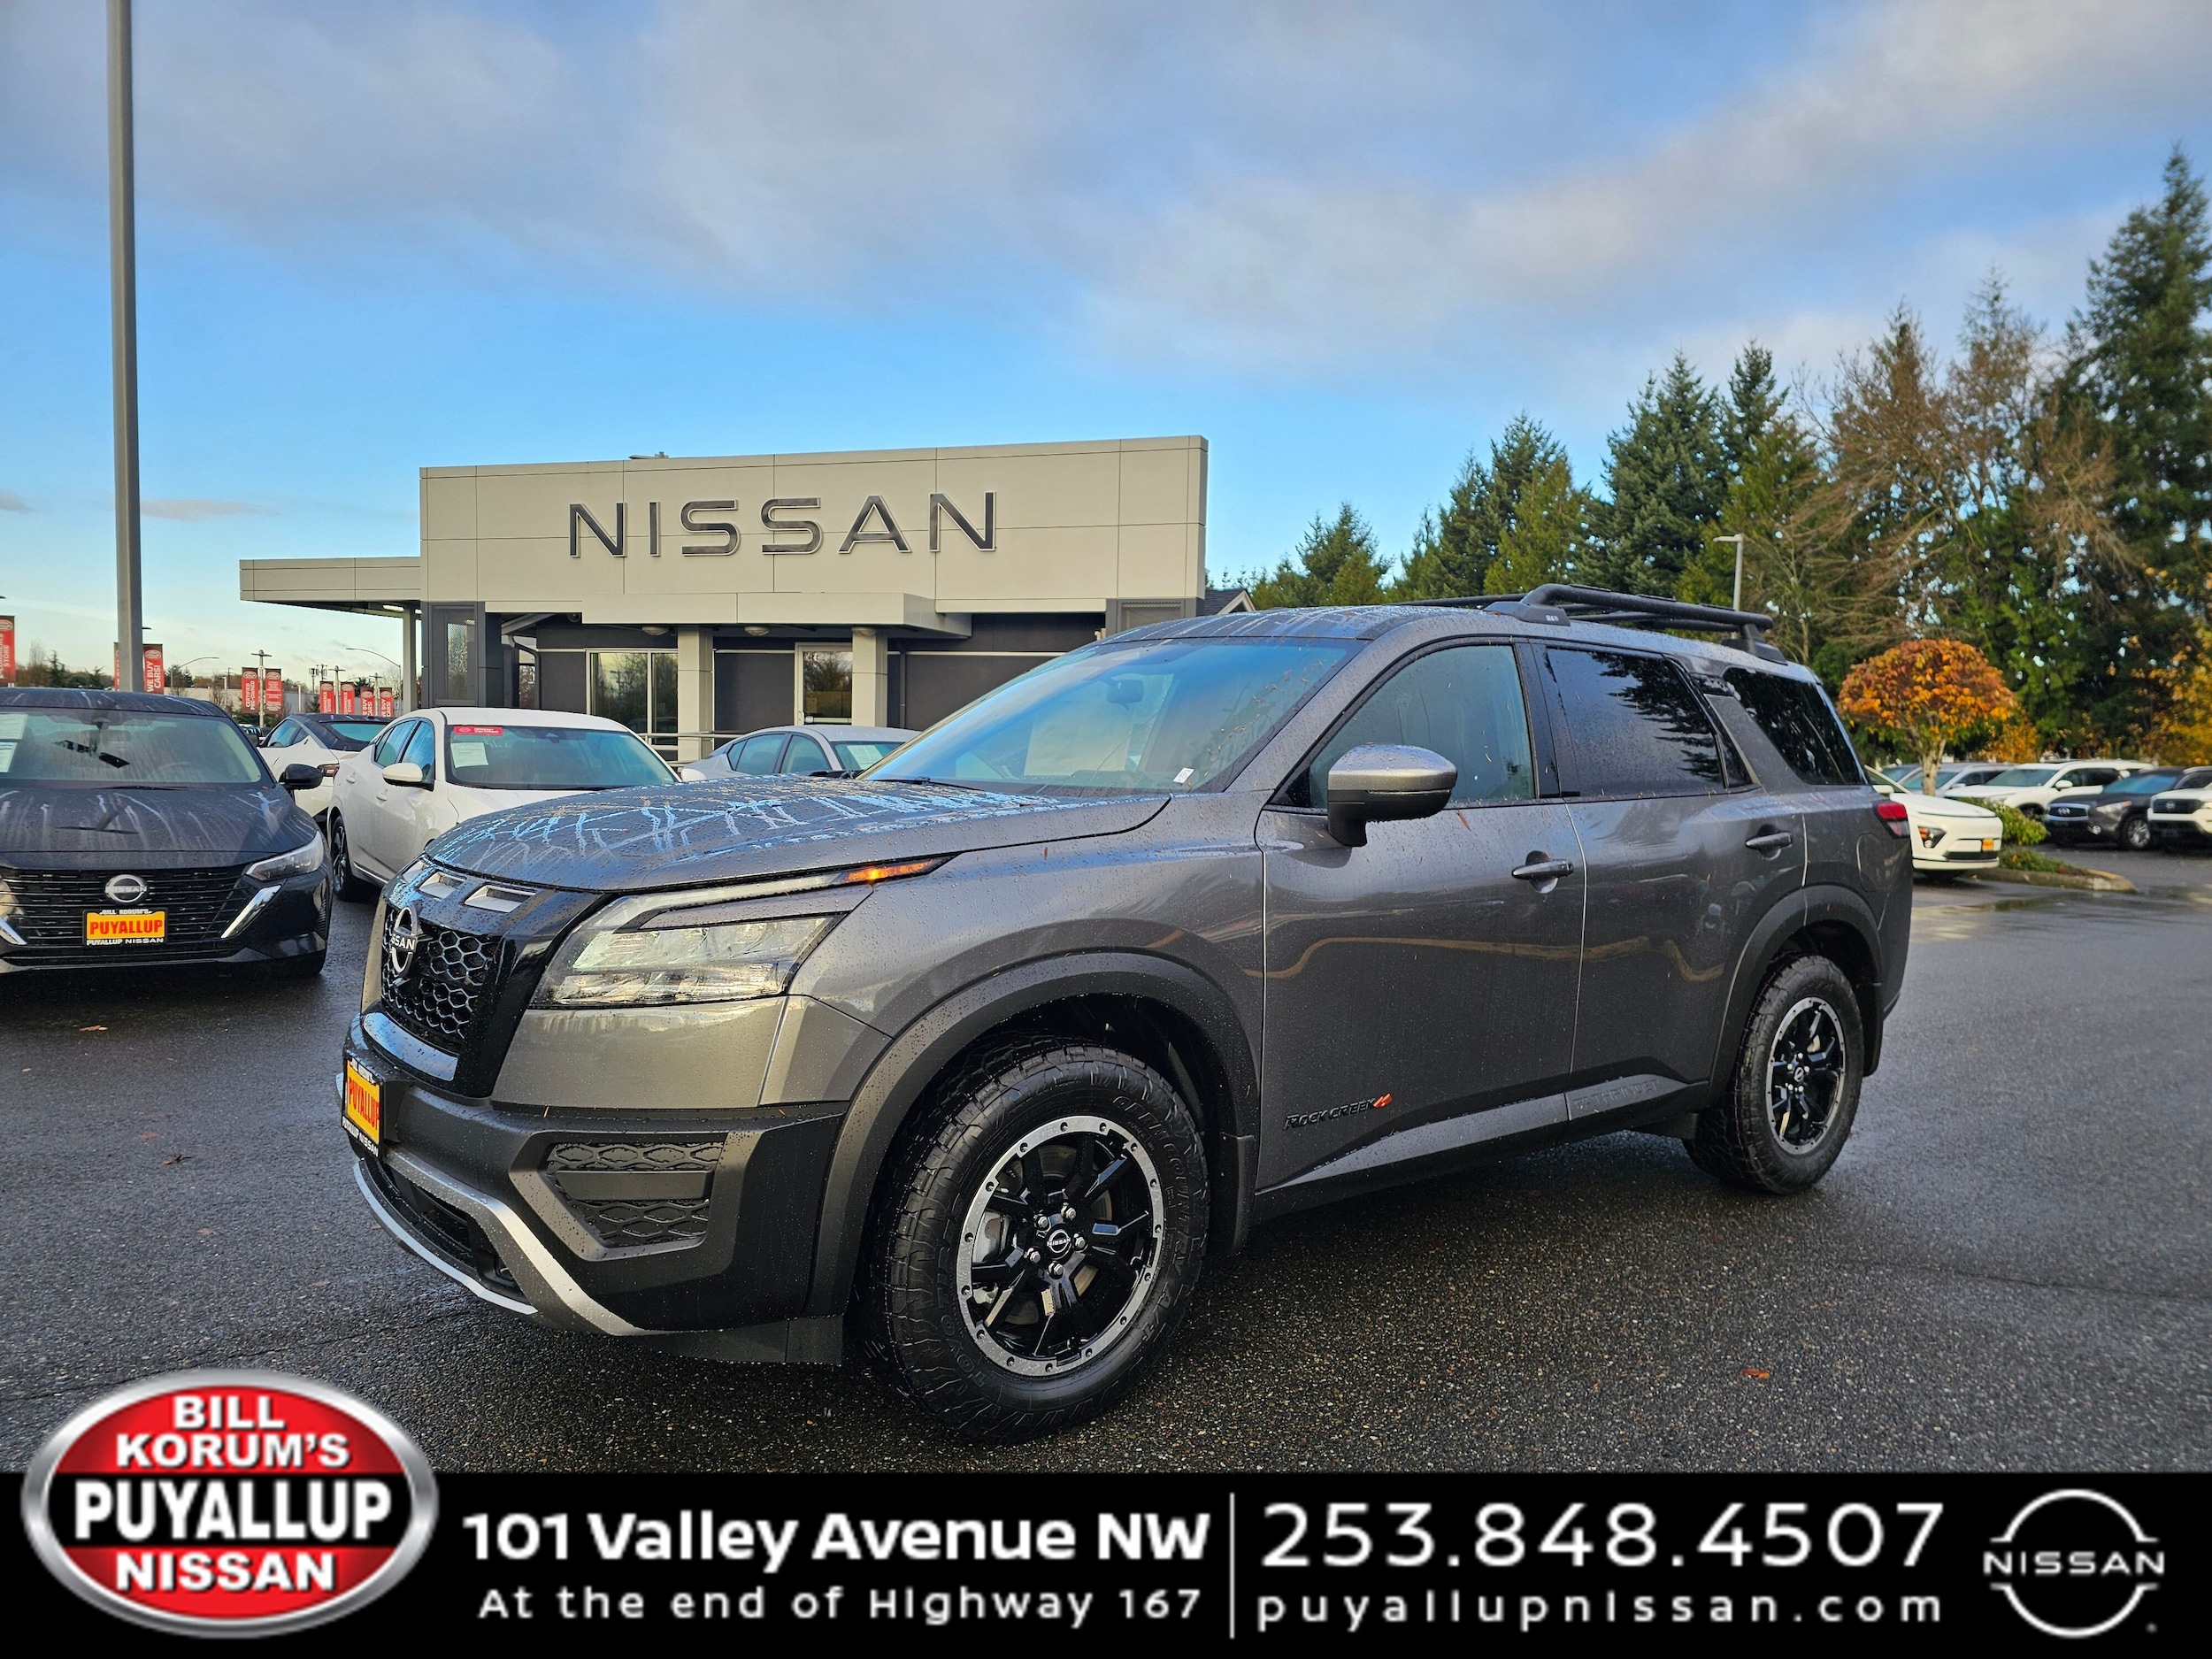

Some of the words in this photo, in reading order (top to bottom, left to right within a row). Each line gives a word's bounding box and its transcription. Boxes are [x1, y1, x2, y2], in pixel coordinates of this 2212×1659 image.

[569, 491, 996, 557] NISSAN
[146, 679, 154, 693] WE
[153, 664, 162, 689] CARS!
[89, 919, 163, 935] PUYALLUP
[390, 933, 416, 951] SSAN
[348, 1075, 380, 1131] PUYALLUP
